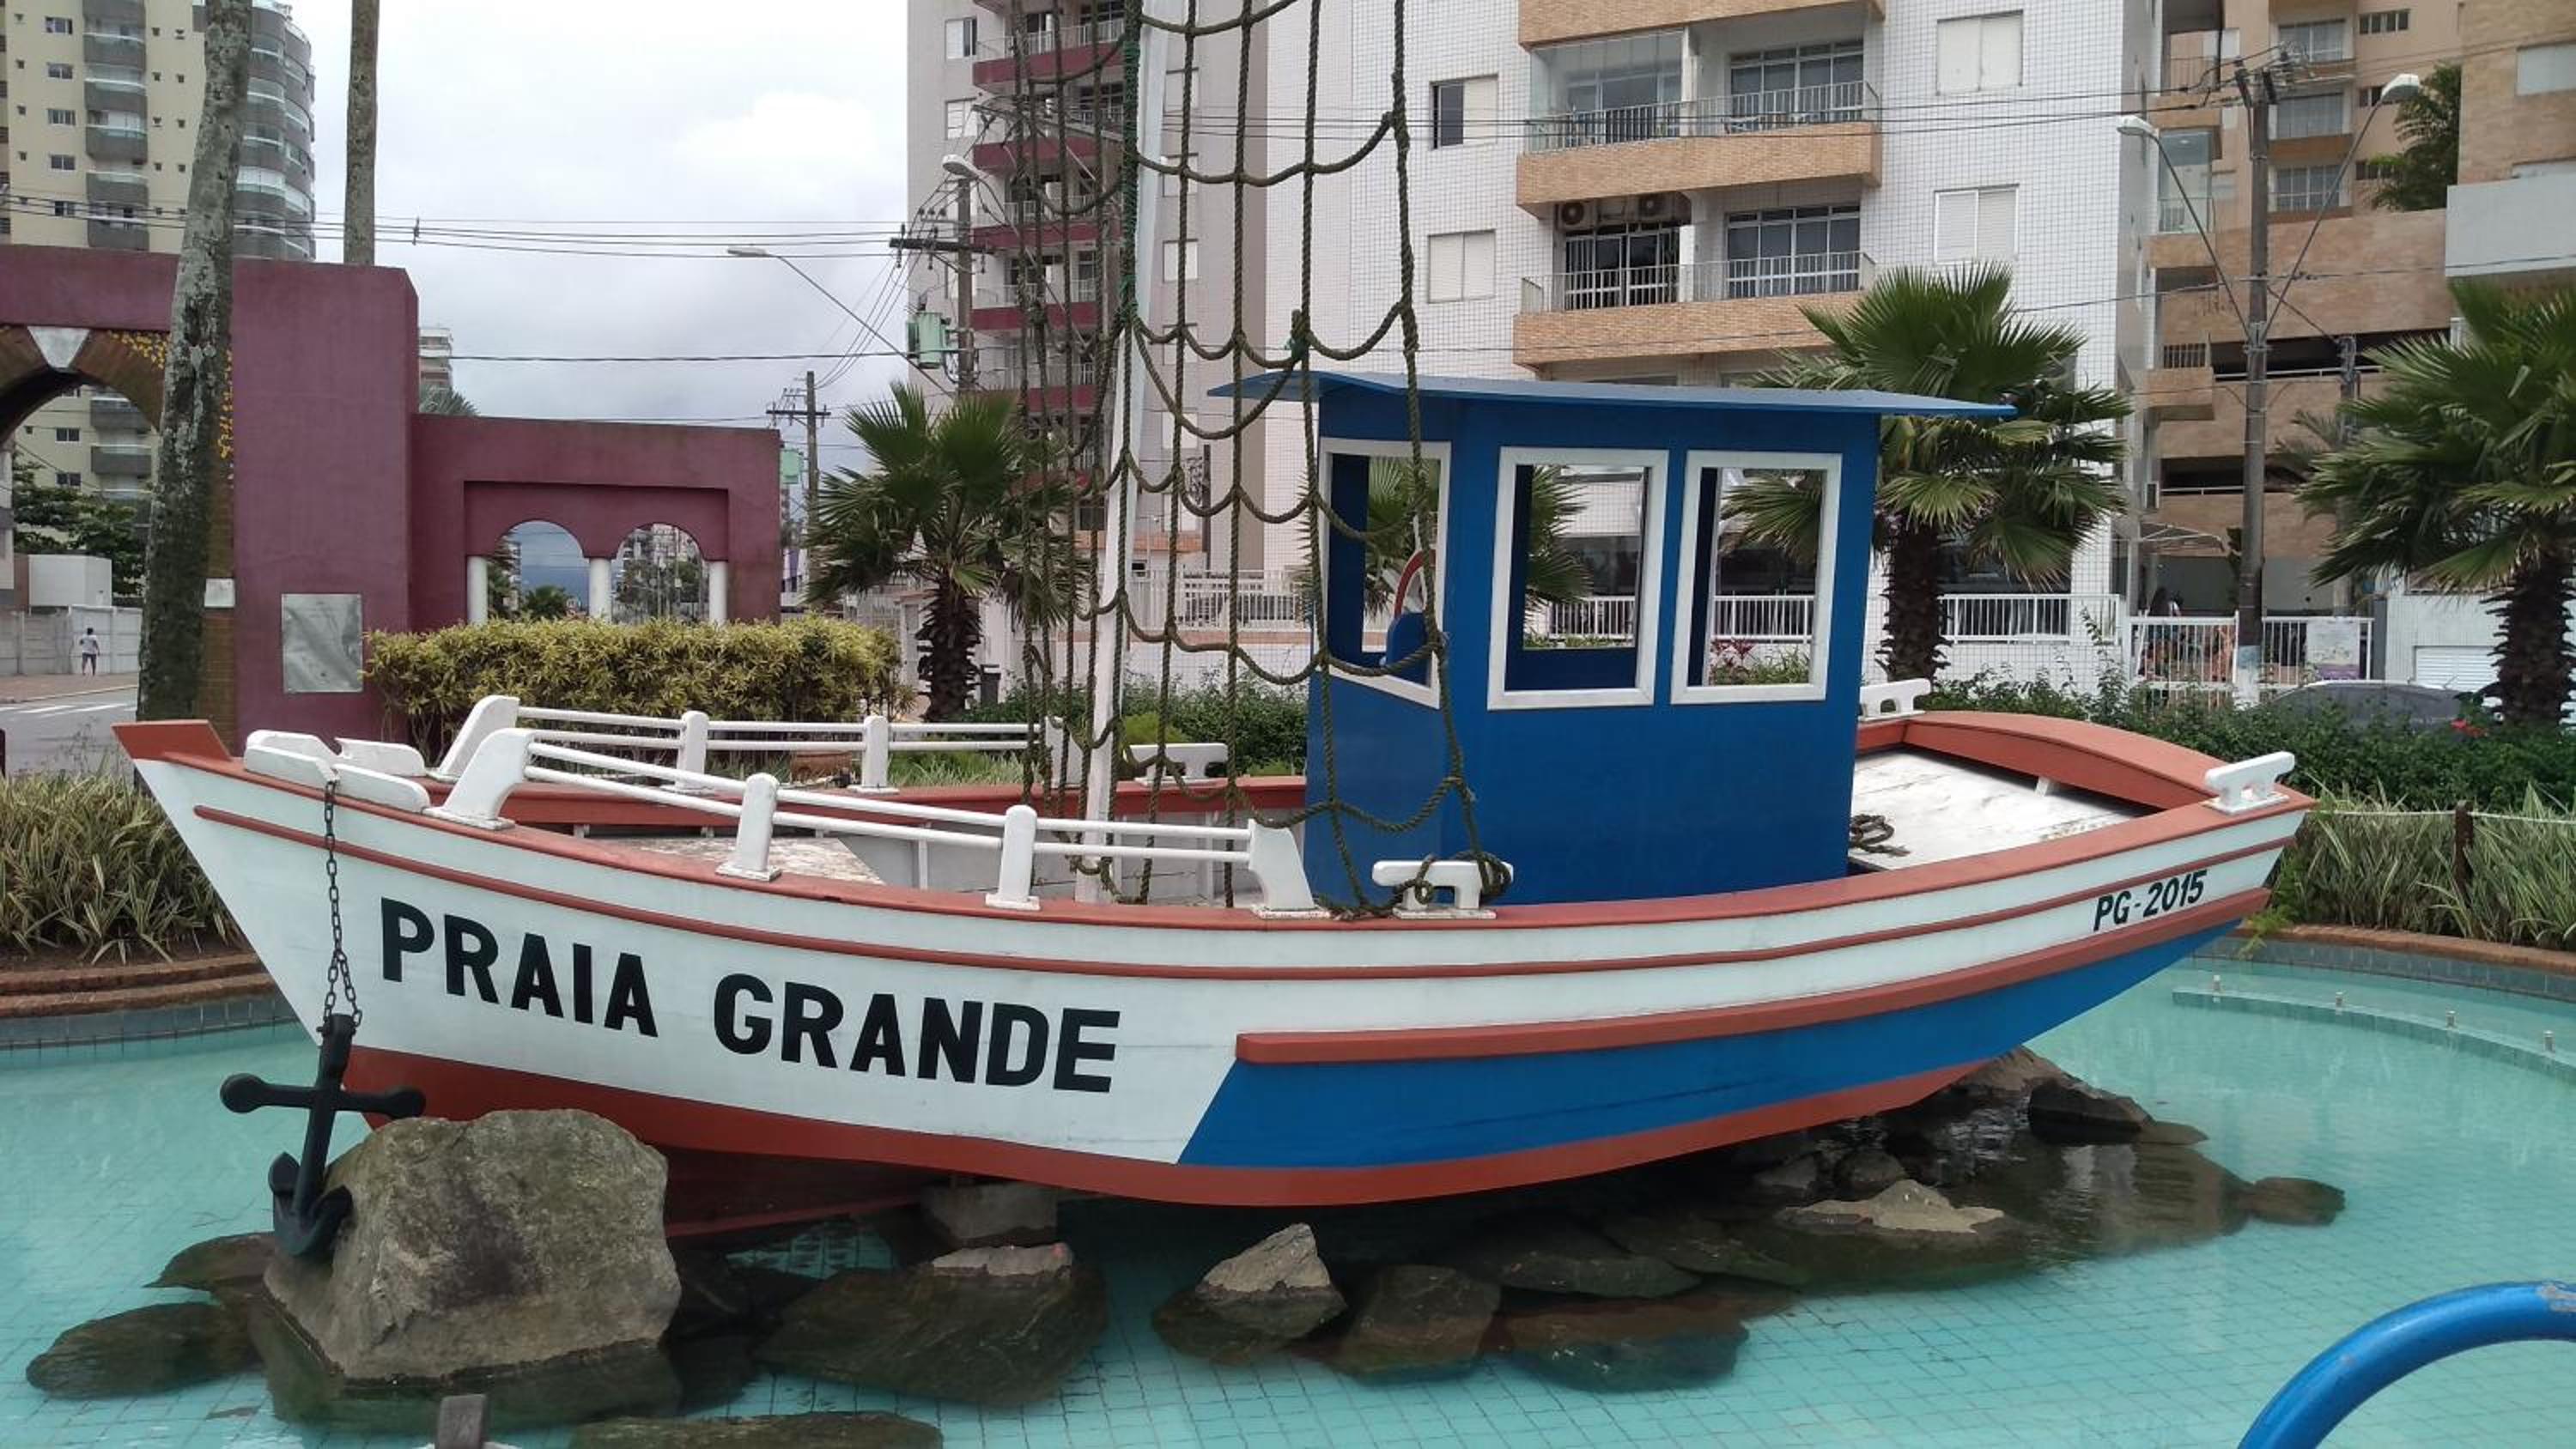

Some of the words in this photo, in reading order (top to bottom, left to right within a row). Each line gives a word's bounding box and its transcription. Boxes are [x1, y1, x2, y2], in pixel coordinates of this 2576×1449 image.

[2093, 869, 2208, 932] PG-2015
[380, 897, 659, 1038] PRAIA
[714, 973, 1121, 1093] GRANDE
